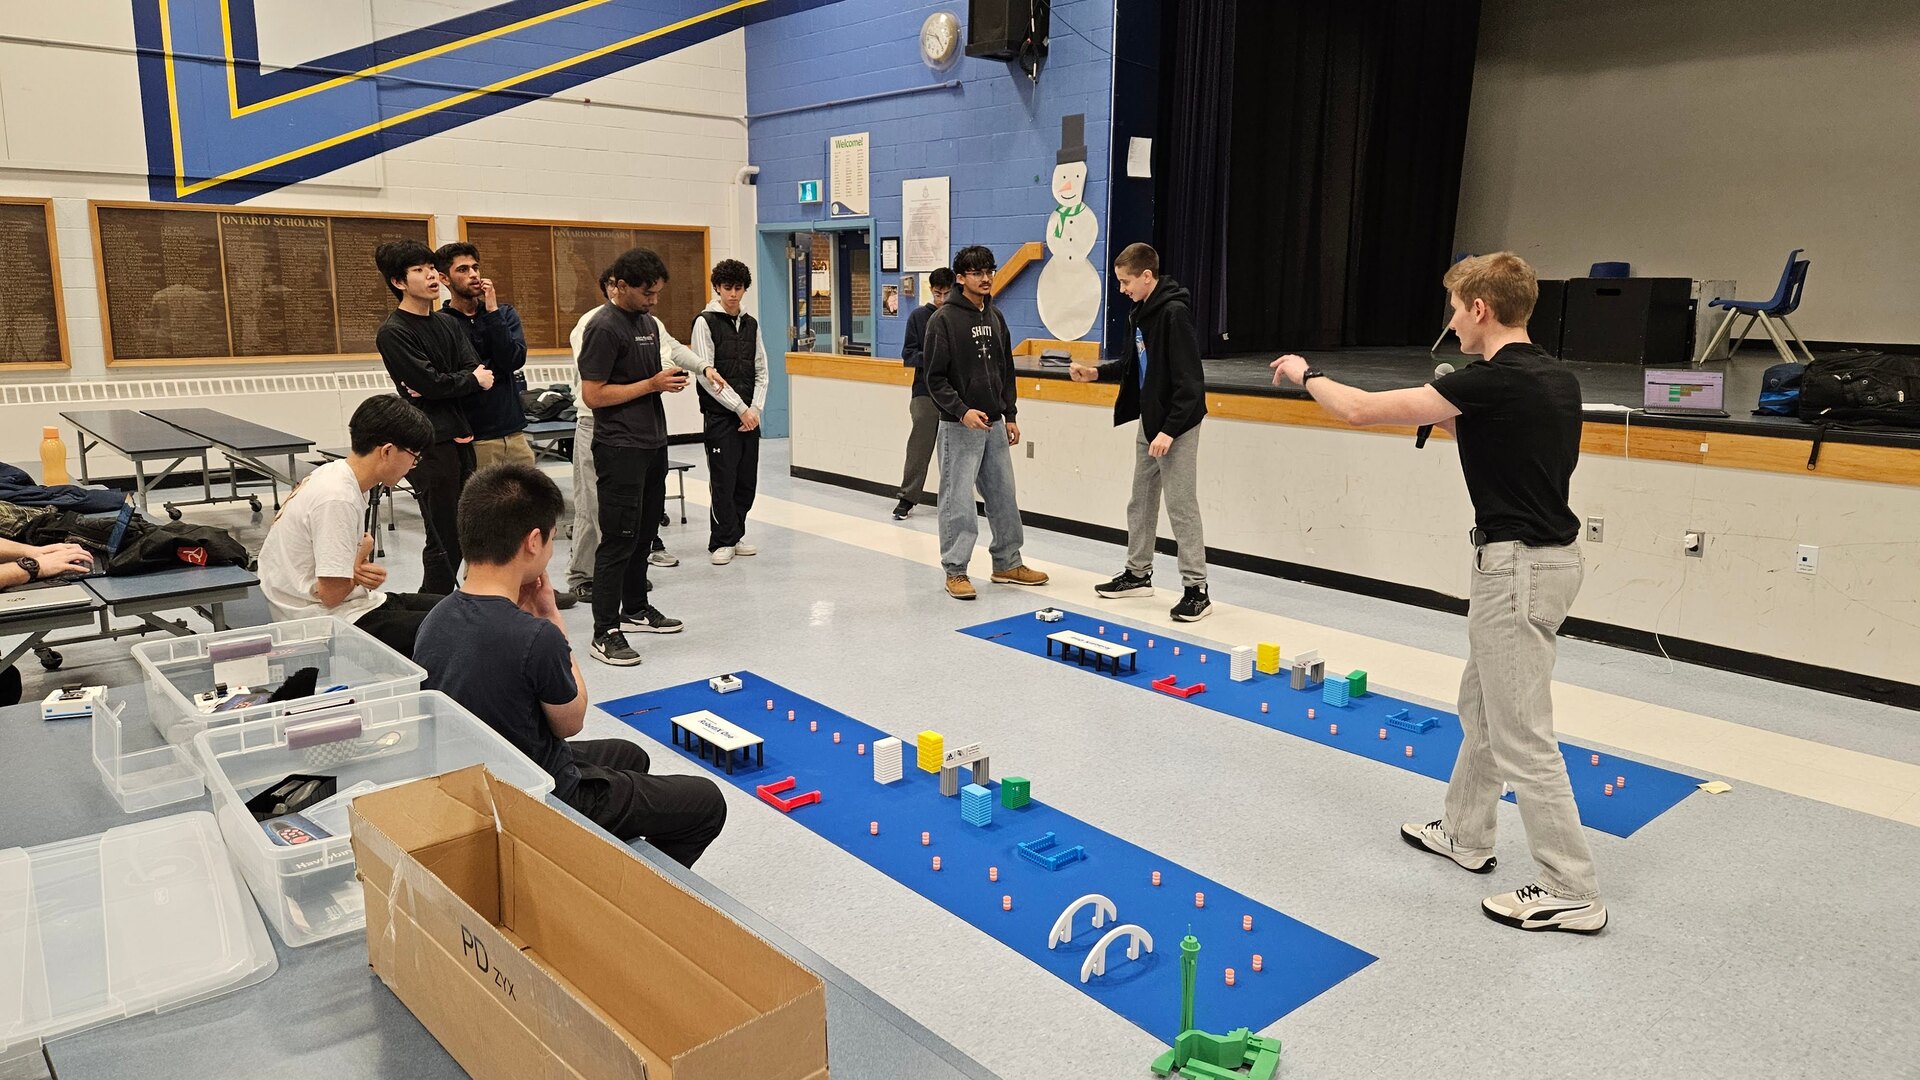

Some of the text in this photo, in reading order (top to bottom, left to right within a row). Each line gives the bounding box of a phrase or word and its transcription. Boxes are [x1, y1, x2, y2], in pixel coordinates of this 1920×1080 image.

[834, 136, 864, 150] Welcome!
[221, 215, 326, 229] ONTARIO SCHOLARS
[553, 229, 630, 240] ONTARIO SCHOLARS
[461, 923, 489, 974] PD
